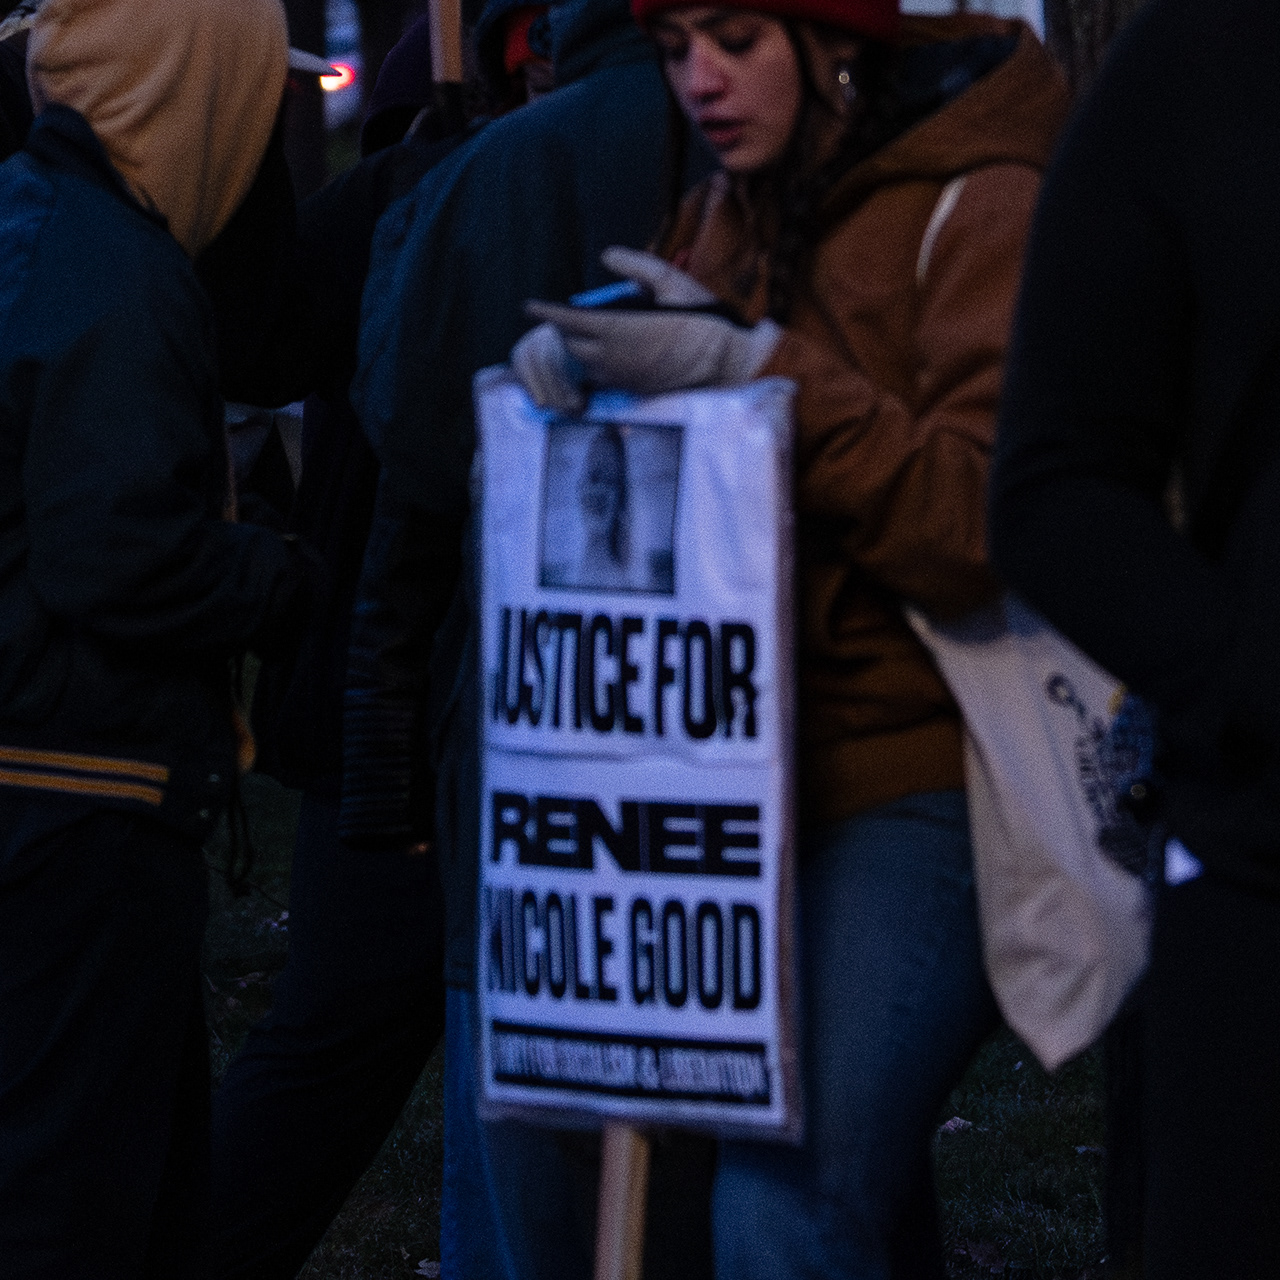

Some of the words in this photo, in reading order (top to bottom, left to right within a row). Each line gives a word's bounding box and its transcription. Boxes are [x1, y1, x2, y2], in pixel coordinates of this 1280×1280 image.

[655, 617, 756, 739] FOR
[492, 793, 760, 876] RENEE
[630, 897, 762, 1010] GOOD
